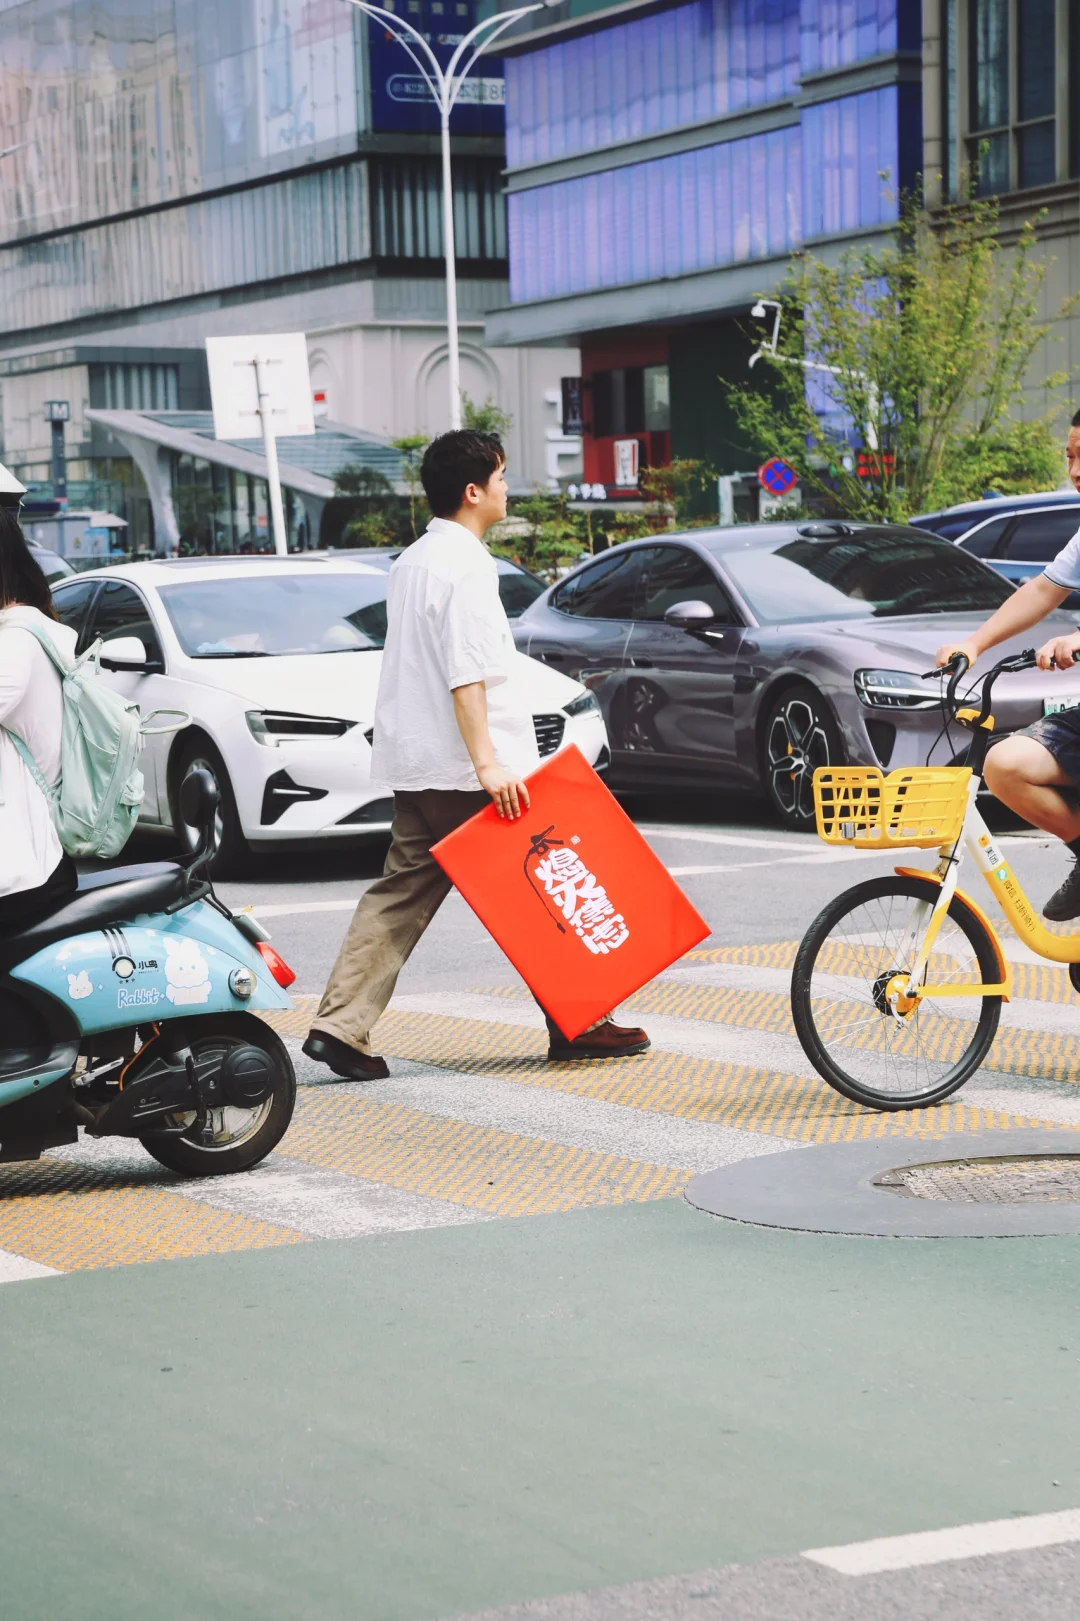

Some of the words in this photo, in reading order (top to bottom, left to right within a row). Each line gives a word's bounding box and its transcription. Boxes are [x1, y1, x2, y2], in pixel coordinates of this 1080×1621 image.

[985, 846, 999, 866] 美团
[534, 847, 630, 955] 熄灭焦虑
[1003, 880, 1017, 898] 微信
[1014, 898, 1037, 932] 扫码骑行
[118, 988, 159, 1008] Rabbit
